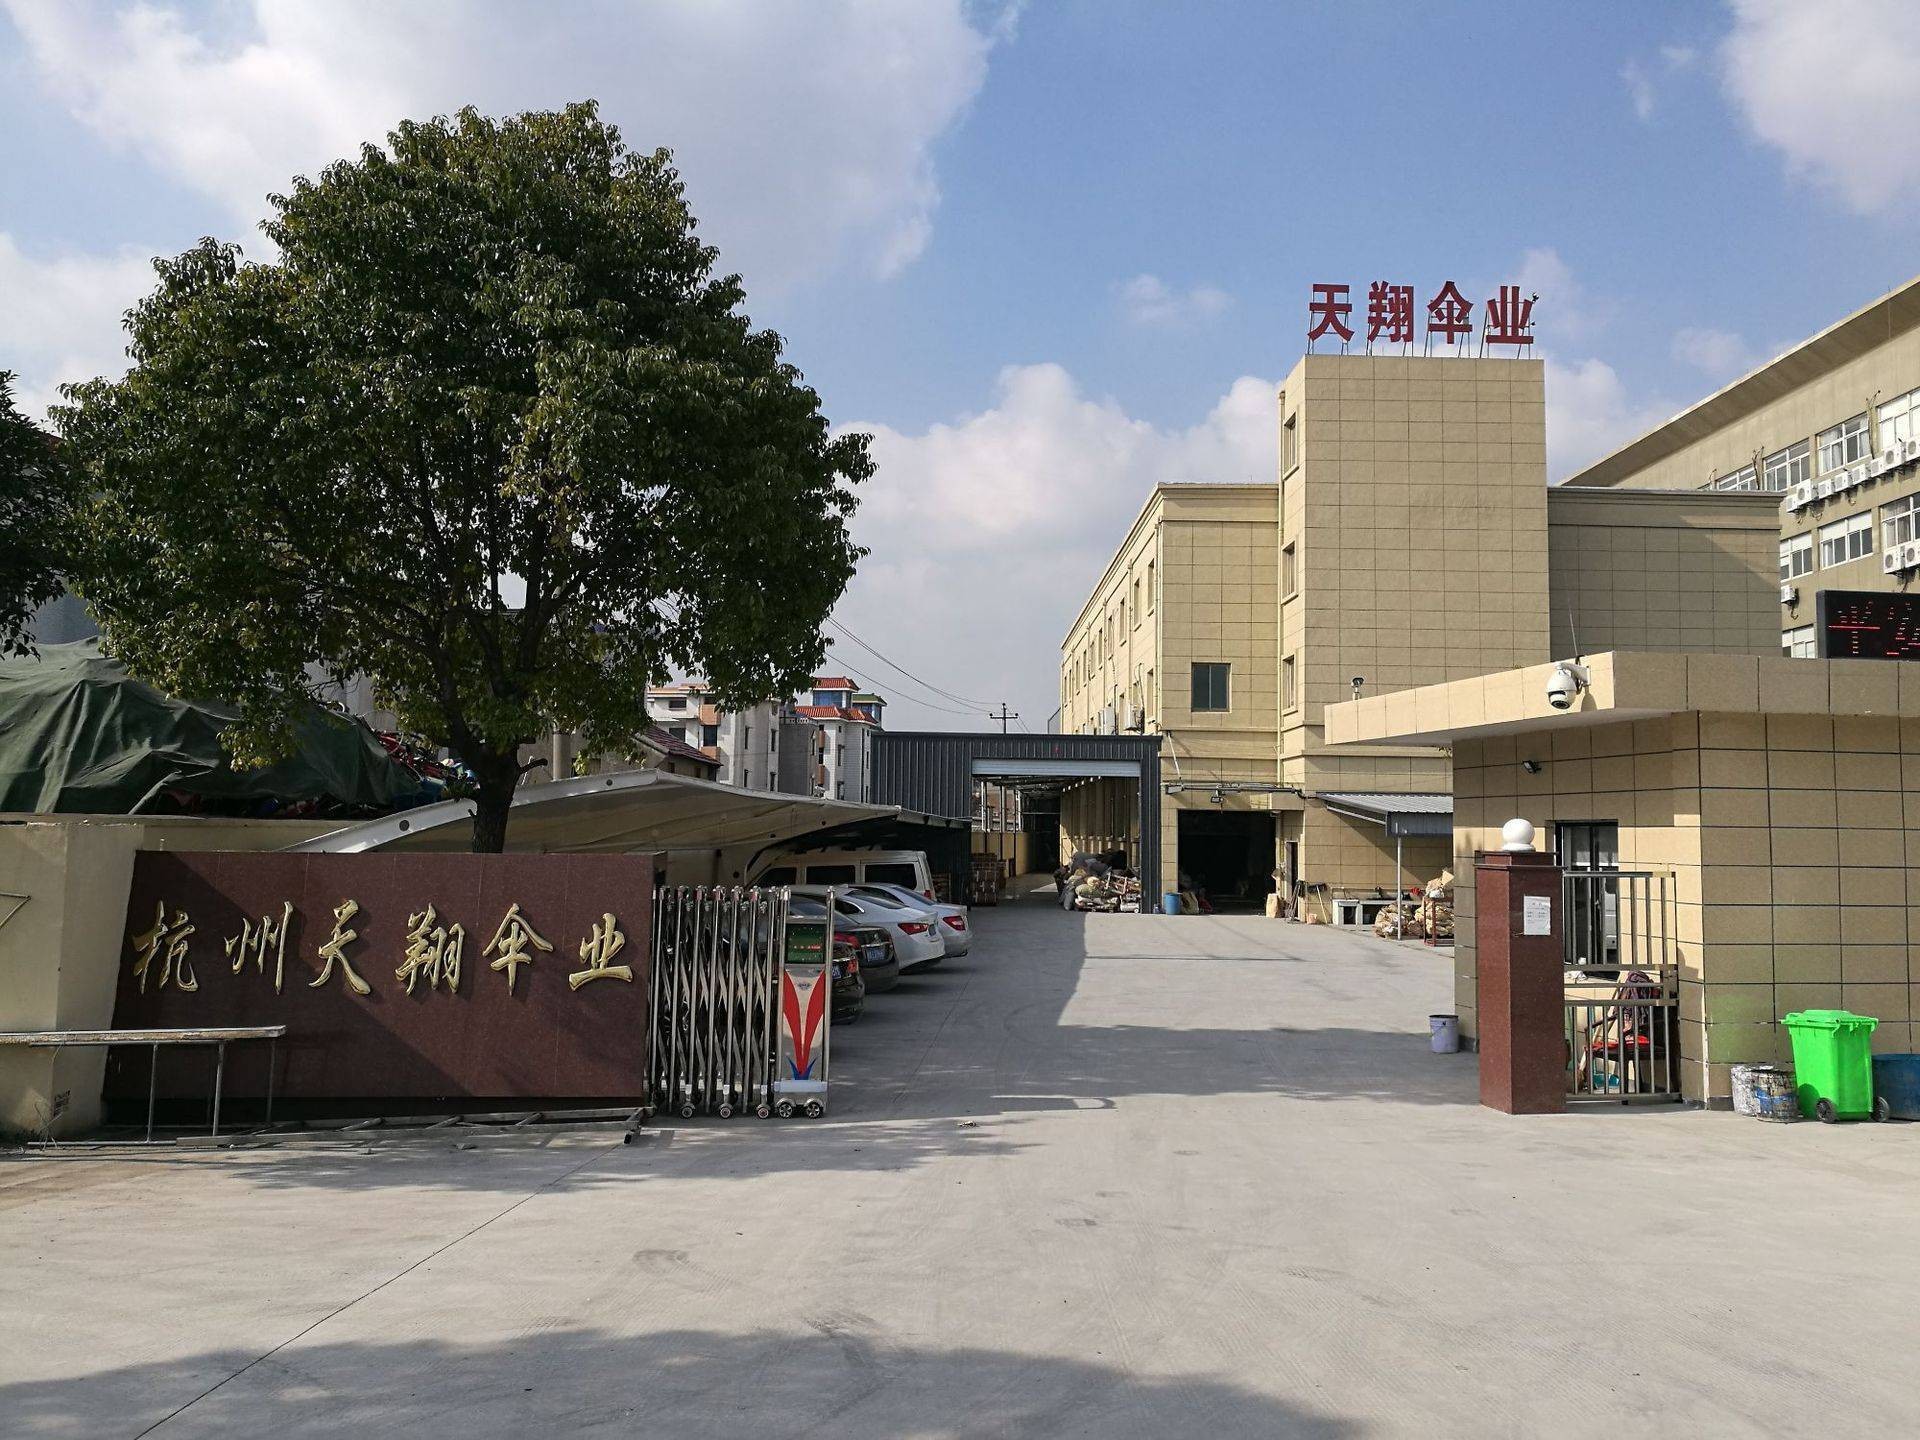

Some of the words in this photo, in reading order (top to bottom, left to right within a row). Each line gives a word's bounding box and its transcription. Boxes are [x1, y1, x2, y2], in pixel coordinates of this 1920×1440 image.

[1307, 281, 1534, 345] 天翔伞业
[132, 899, 633, 996] 杭州天翔伞业
